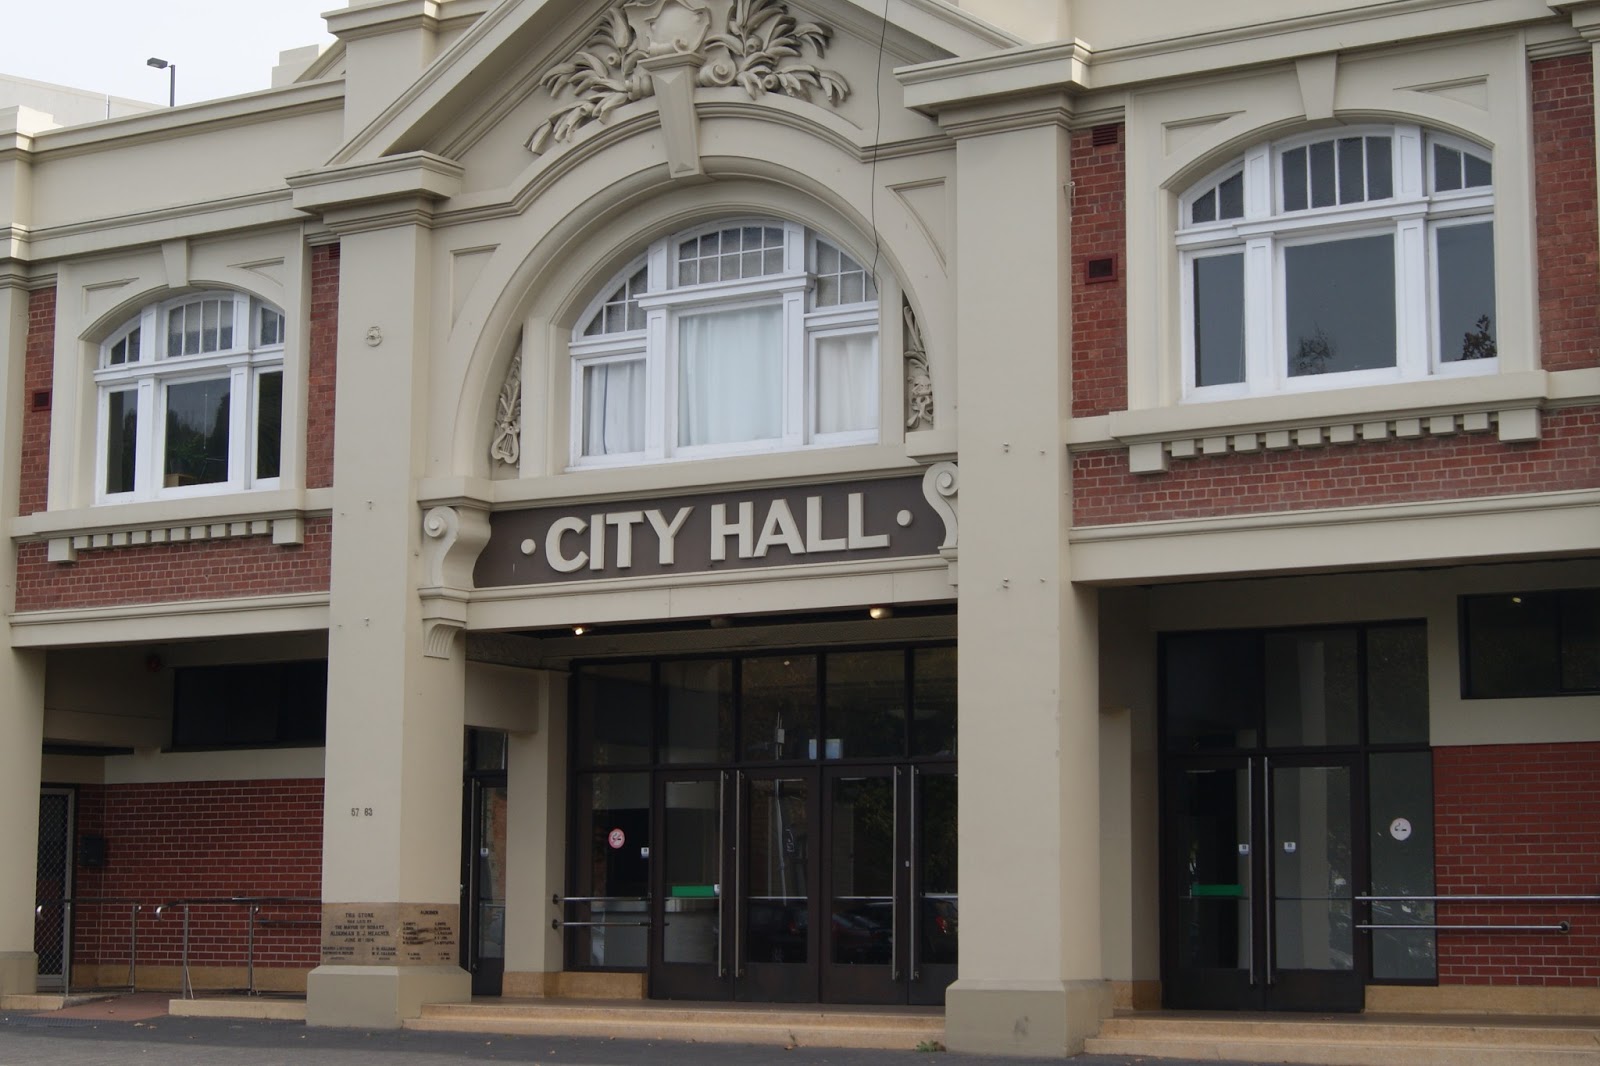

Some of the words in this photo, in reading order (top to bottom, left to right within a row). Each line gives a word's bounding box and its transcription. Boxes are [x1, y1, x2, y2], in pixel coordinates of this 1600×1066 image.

[545, 506, 695, 573] CITY
[710, 492, 891, 561] HALL
[351, 807, 360, 817] 57
